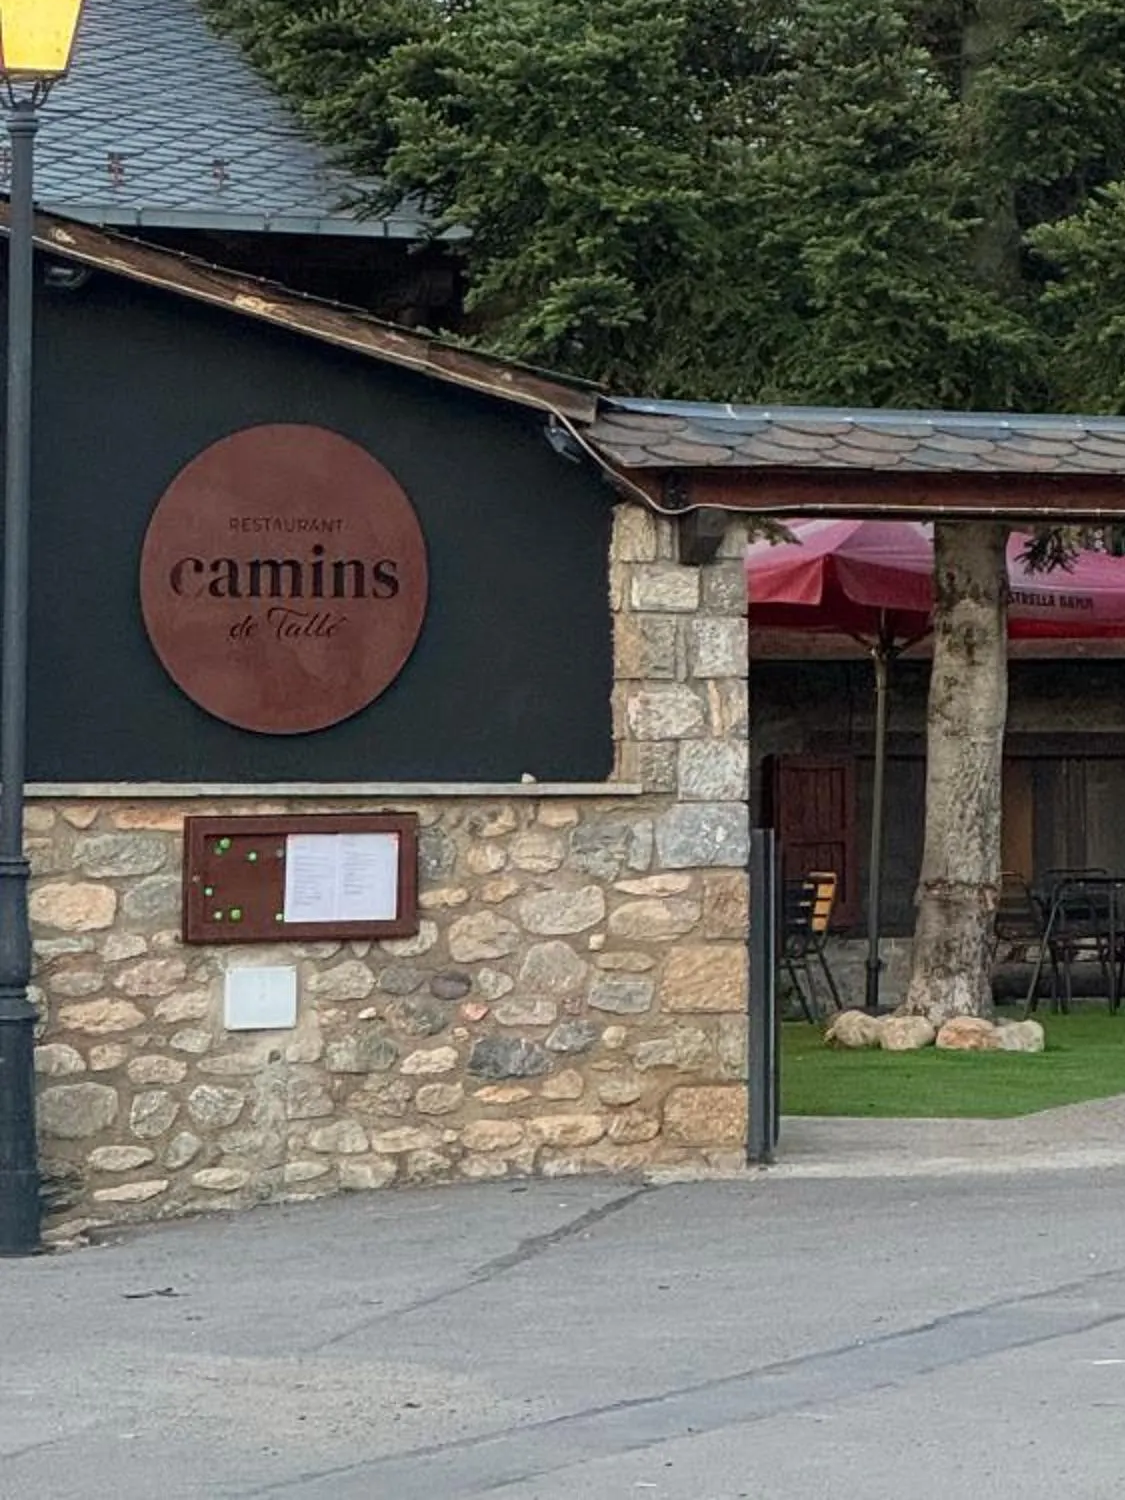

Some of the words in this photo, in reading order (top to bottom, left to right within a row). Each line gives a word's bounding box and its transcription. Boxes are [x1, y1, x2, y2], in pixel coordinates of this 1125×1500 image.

[228, 517, 343, 533] RESTAURANT
[169, 544, 399, 599] camins
[1007, 591, 1056, 607] STRELLA
[229, 614, 258, 640] de
